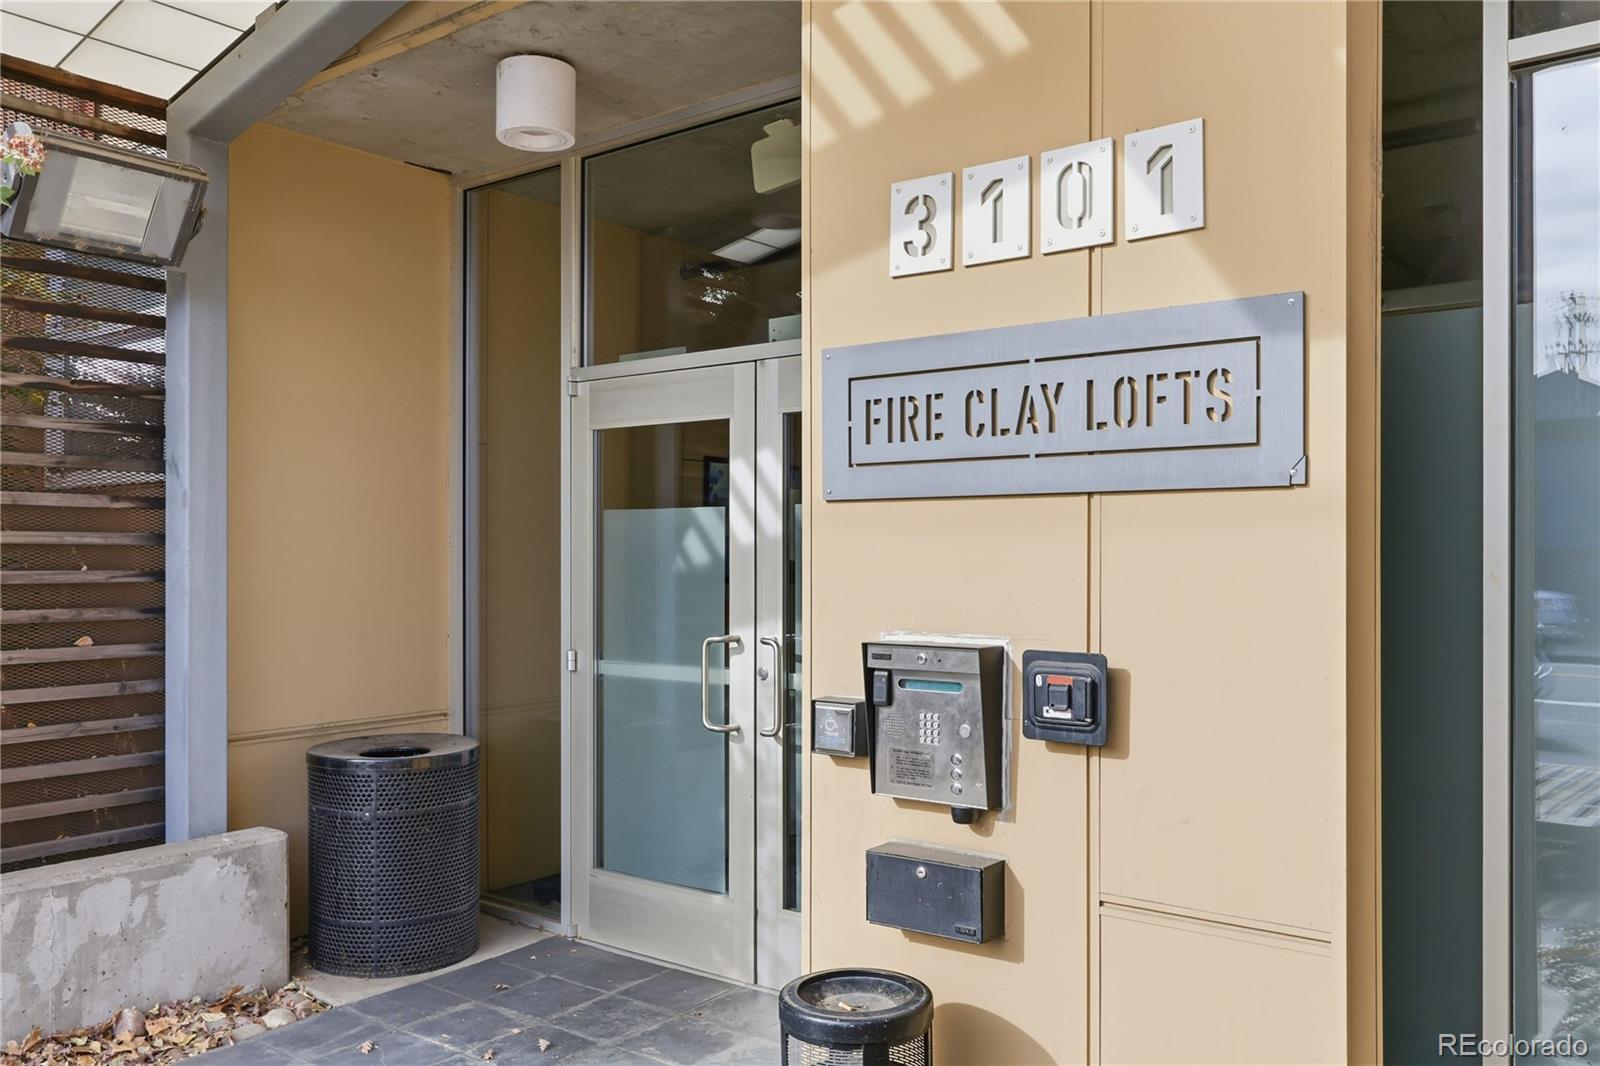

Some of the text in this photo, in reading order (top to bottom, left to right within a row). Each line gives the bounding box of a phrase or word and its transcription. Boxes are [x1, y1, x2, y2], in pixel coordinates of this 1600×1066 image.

[903, 143, 1174, 258] 3101
[865, 368, 1233, 445] FIRE CLAY LOFTS
